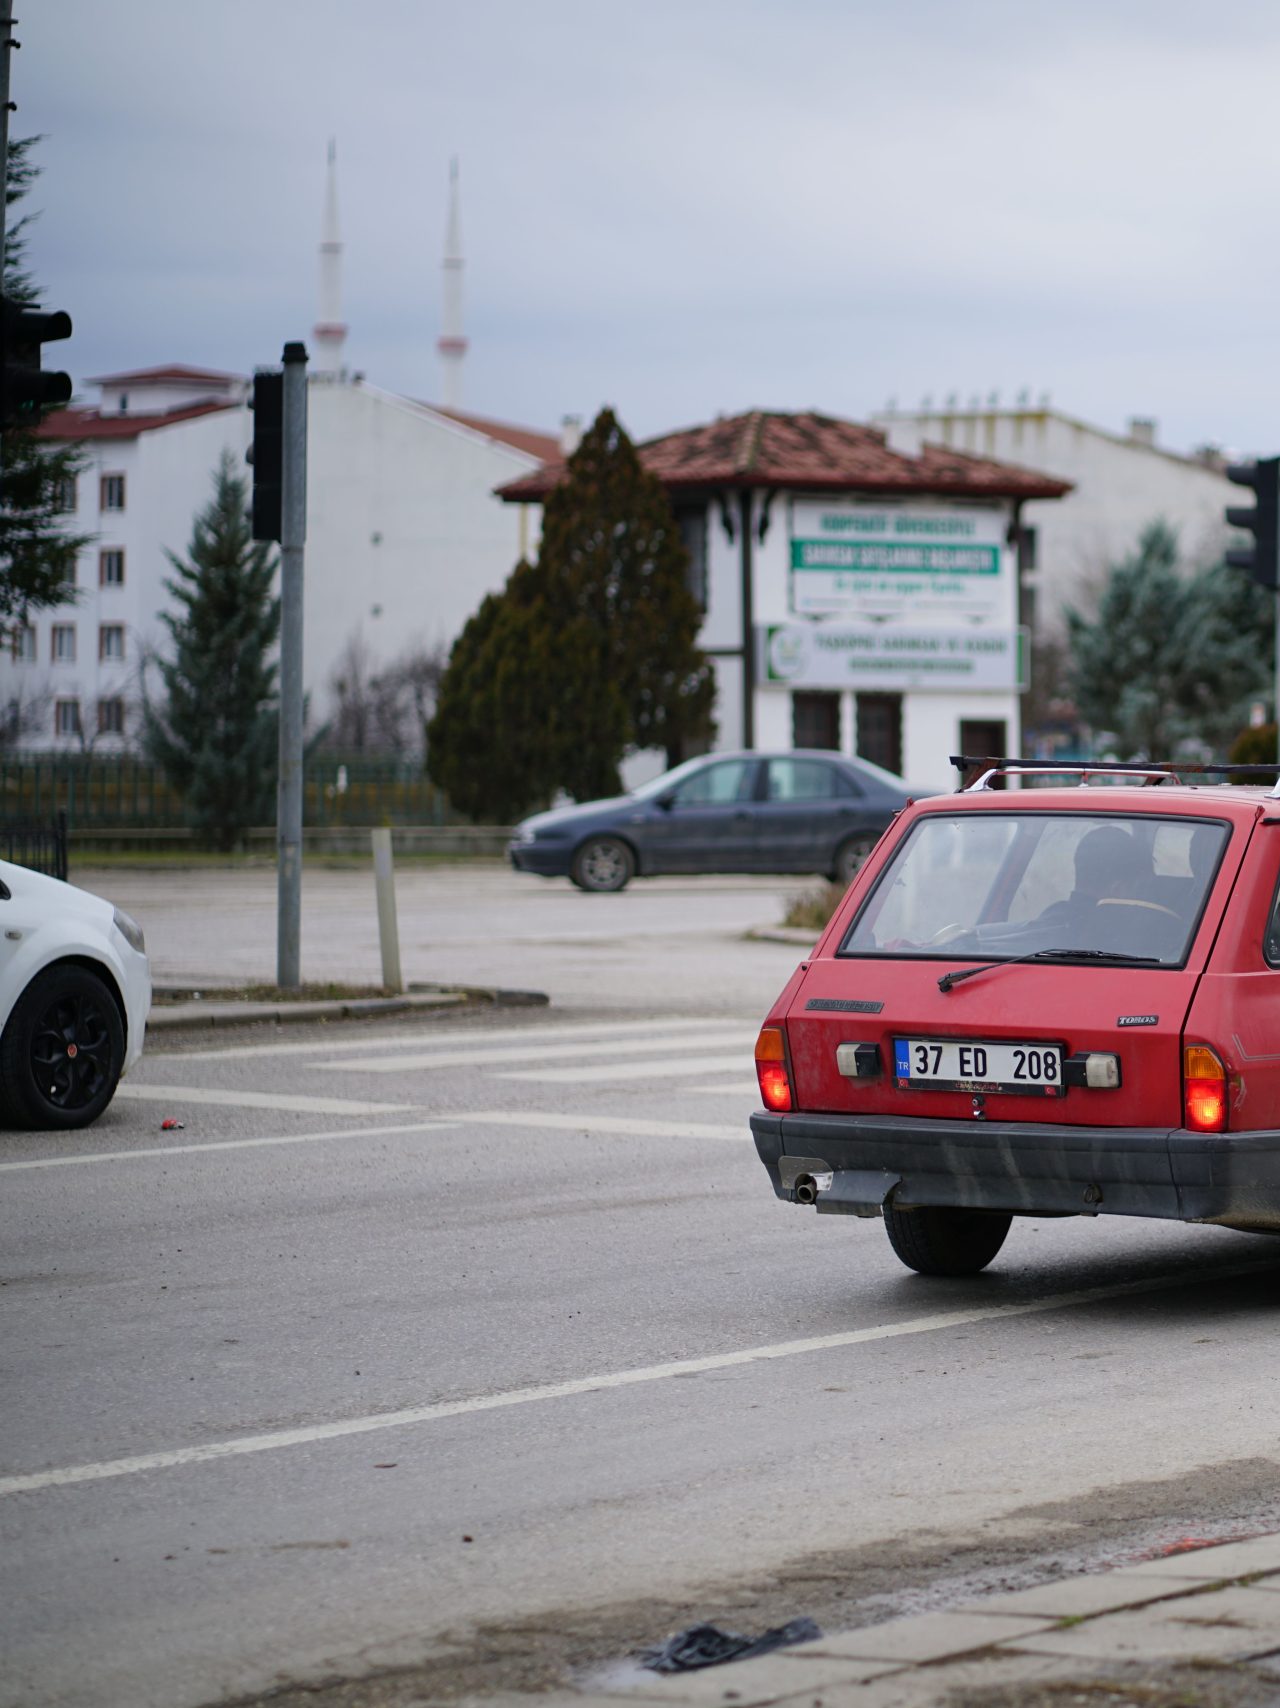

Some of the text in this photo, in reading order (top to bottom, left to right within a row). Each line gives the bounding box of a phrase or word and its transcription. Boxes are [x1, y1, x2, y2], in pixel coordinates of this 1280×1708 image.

[1119, 1016, 1156, 1025] TOROS
[898, 1062, 909, 1070] TR
[915, 1045, 1057, 1081] 37 ED 208
